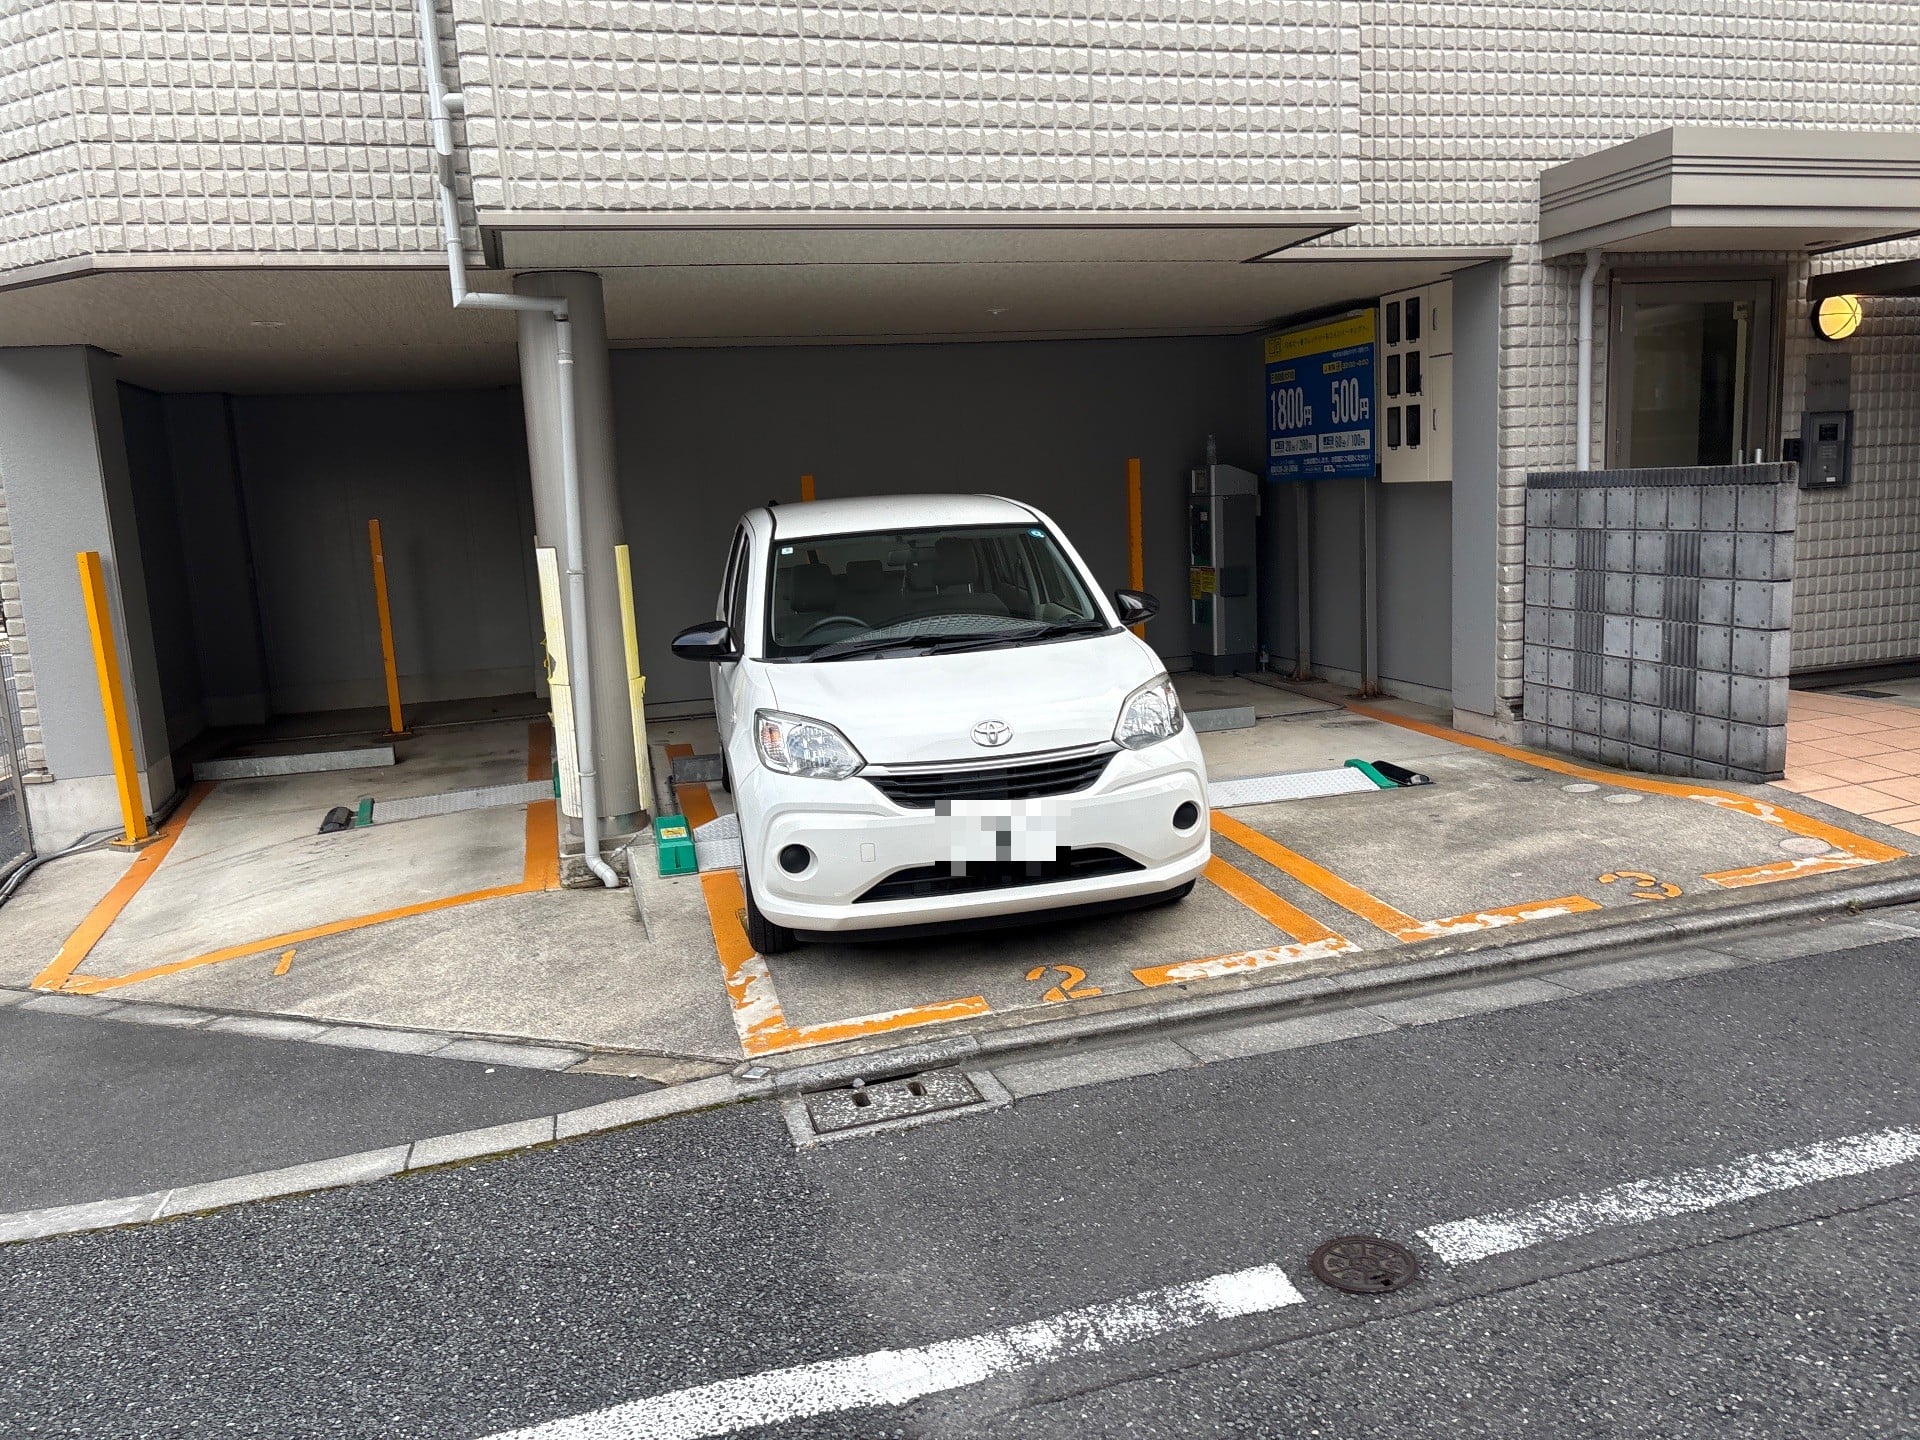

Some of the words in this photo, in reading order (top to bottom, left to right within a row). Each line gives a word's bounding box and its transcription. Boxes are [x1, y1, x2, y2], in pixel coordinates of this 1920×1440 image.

[1270, 386, 1313, 431] 1800円
[1331, 377, 1369, 424] 500円
[1598, 871, 1683, 900] 3
[1025, 964, 1103, 1002] 2
